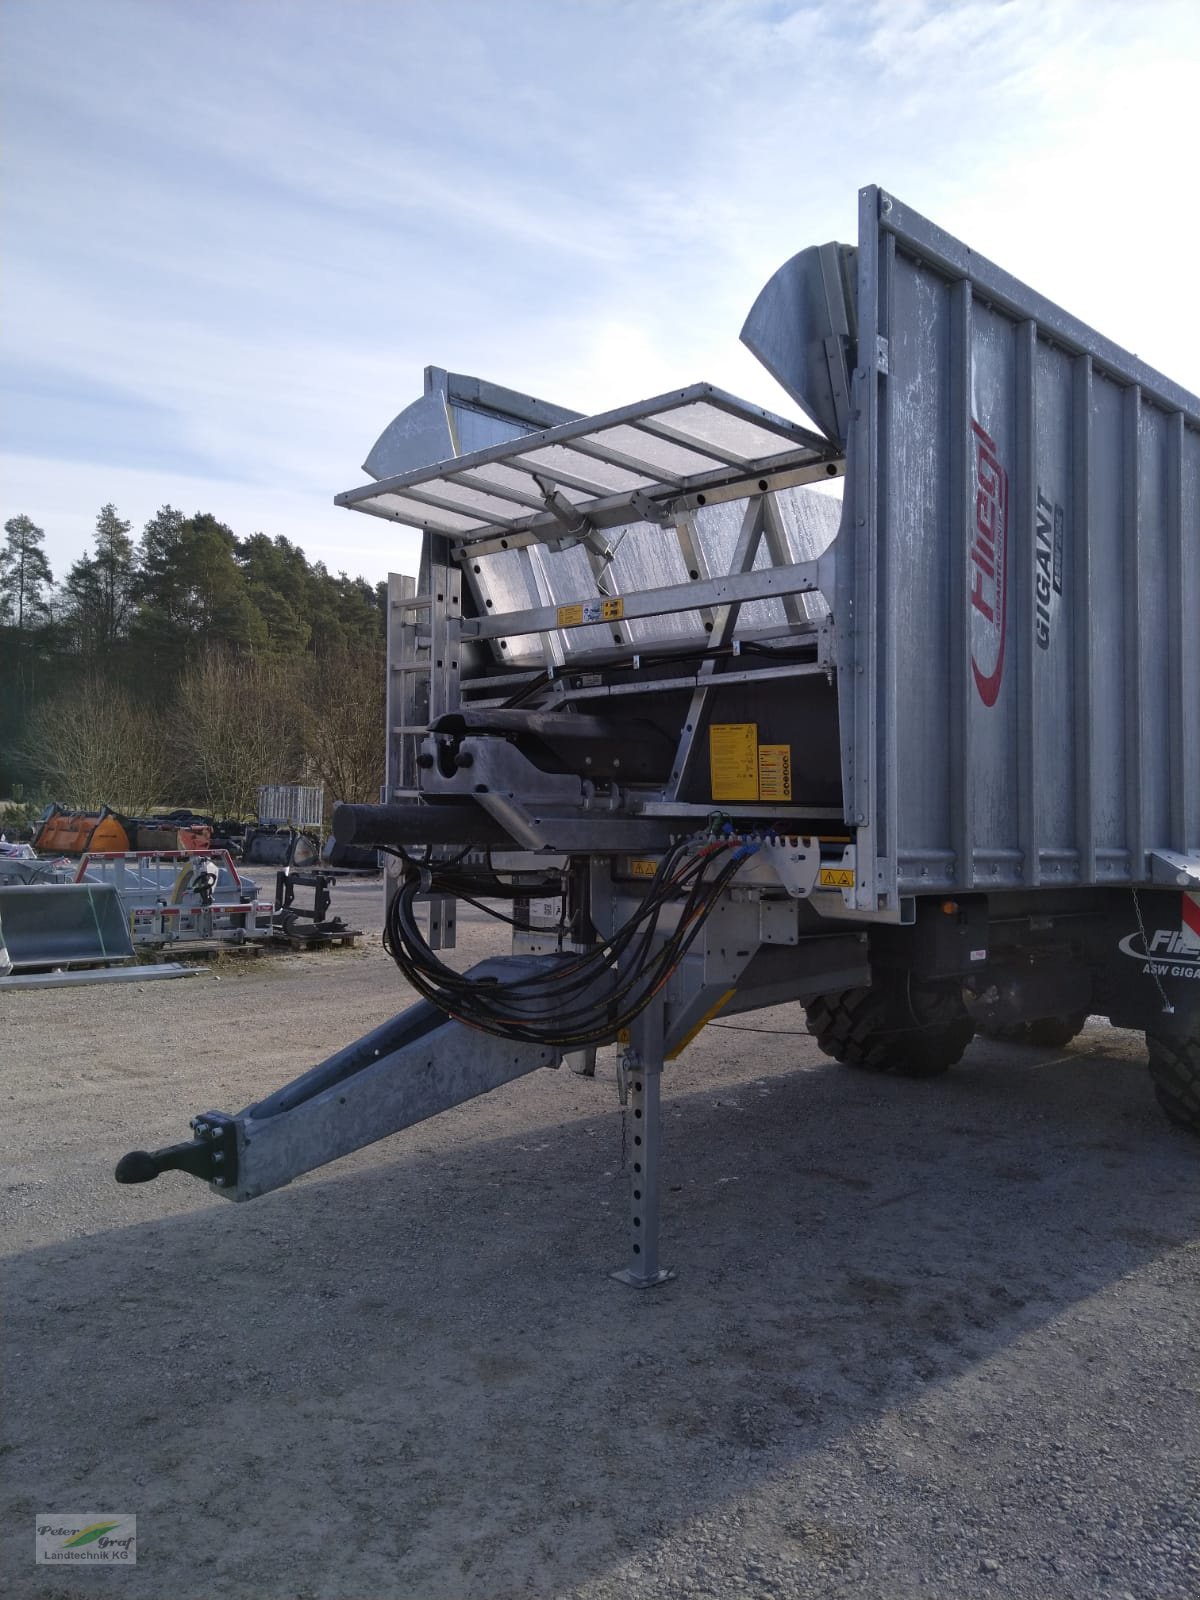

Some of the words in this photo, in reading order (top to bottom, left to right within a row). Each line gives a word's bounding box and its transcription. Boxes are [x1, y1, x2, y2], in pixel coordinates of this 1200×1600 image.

[971, 418, 1004, 624] Fliegl
[1036, 486, 1052, 650] GIGANT
[1142, 963, 1169, 976] ASW
